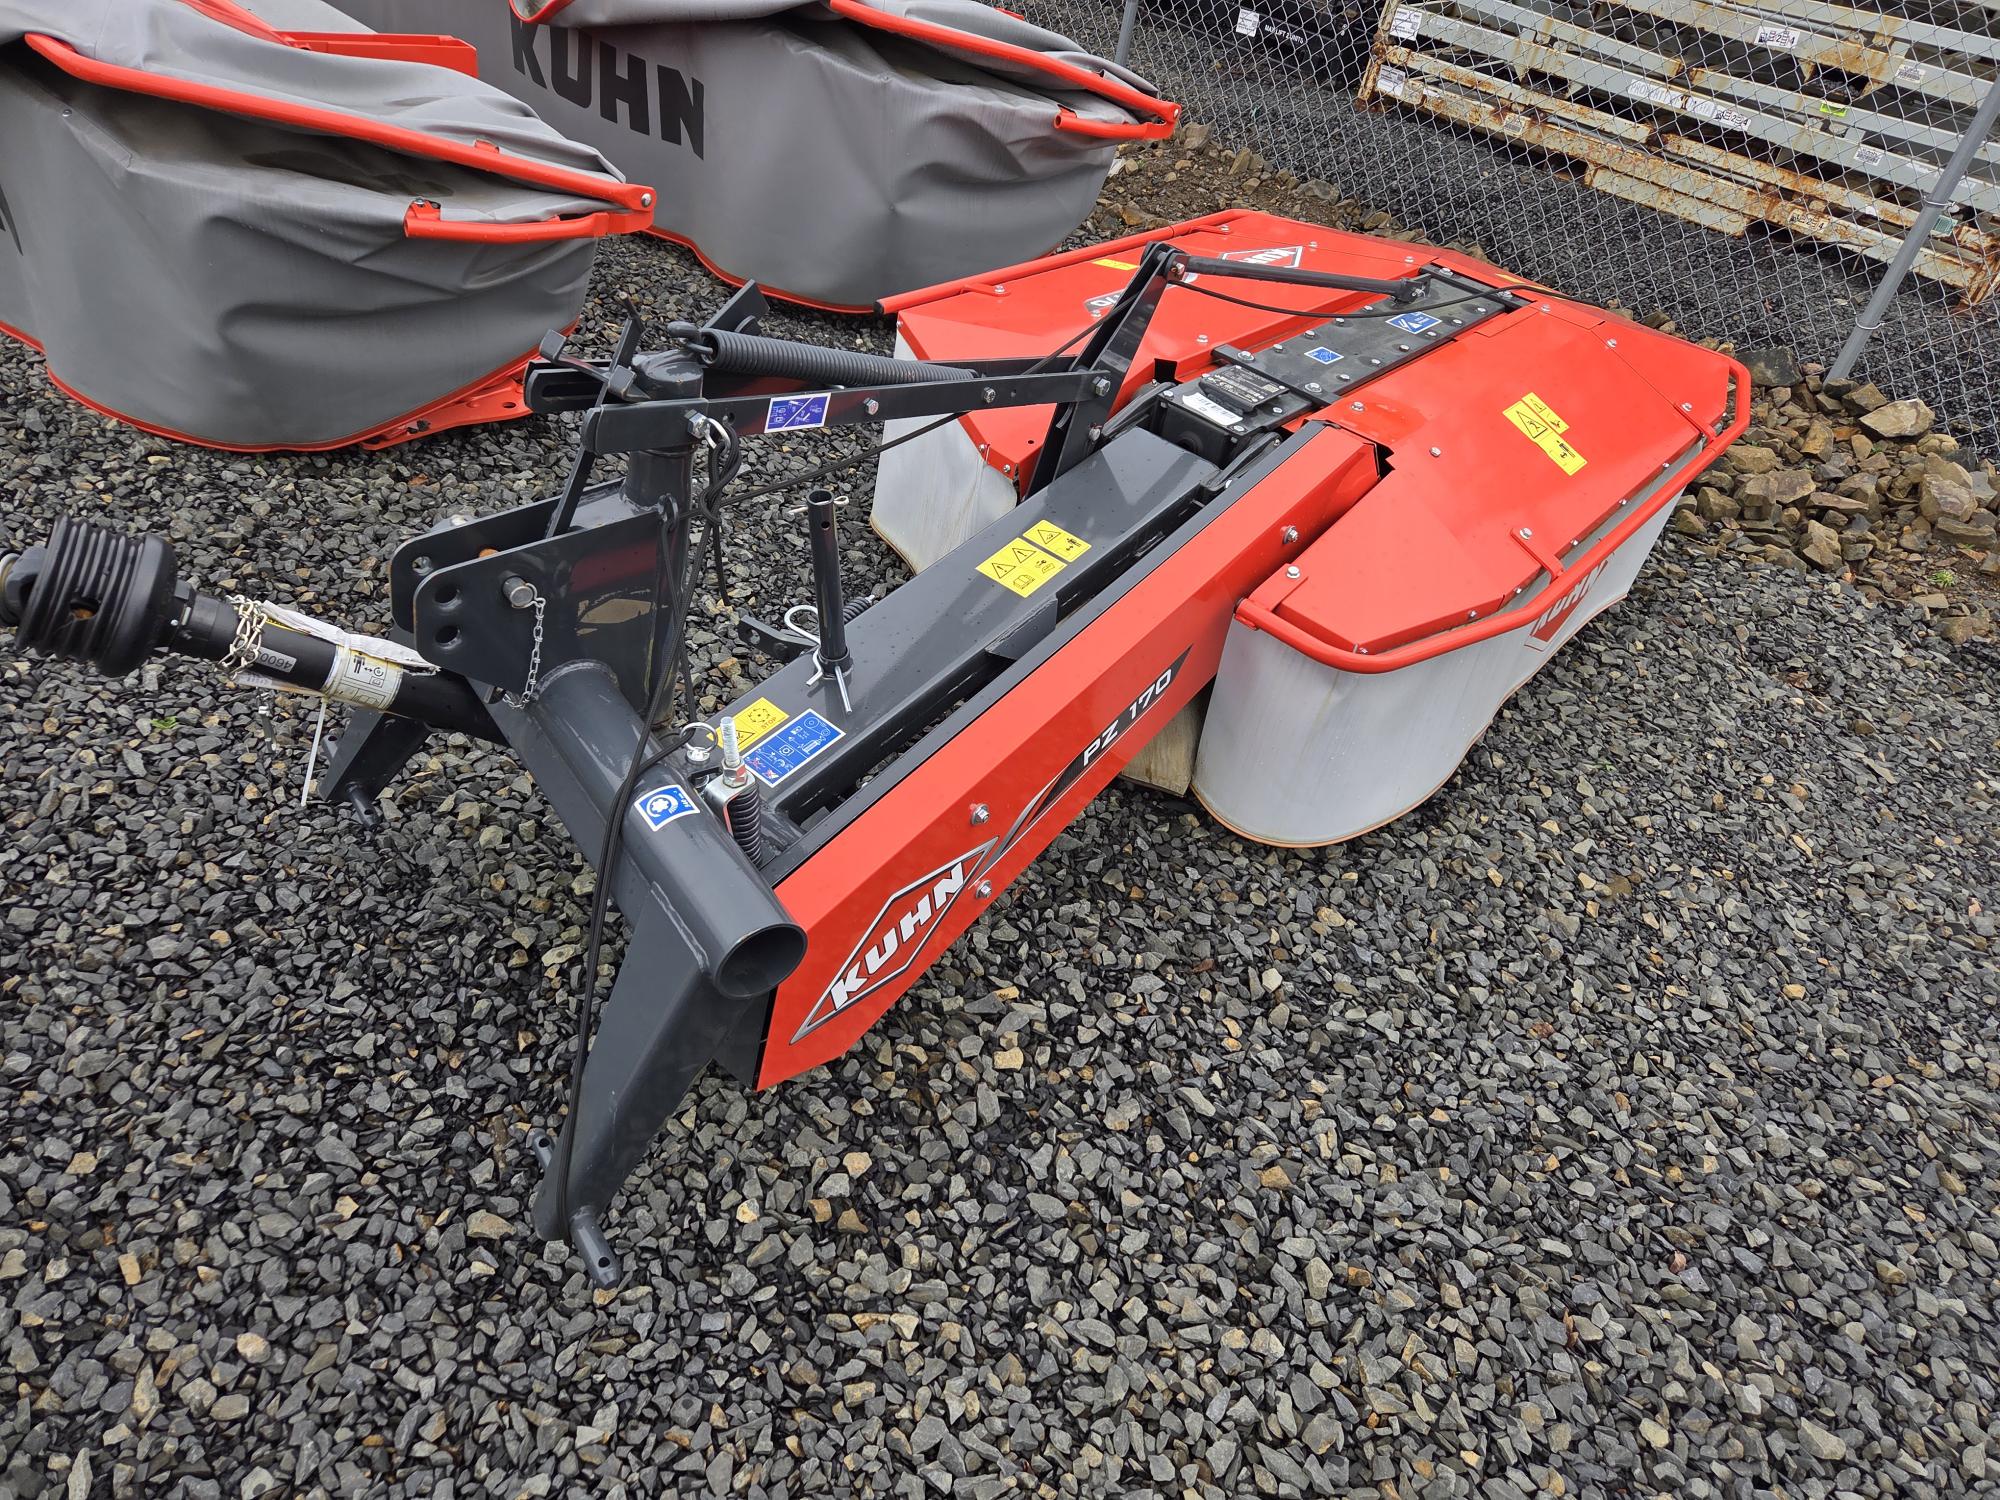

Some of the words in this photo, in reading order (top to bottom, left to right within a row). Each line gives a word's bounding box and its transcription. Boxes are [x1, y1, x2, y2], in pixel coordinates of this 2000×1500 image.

[510, 13, 704, 160] KUHN
[1083, 719, 1119, 767] PZ
[1129, 668, 1172, 720] 170
[830, 861, 964, 1010] KUHN
